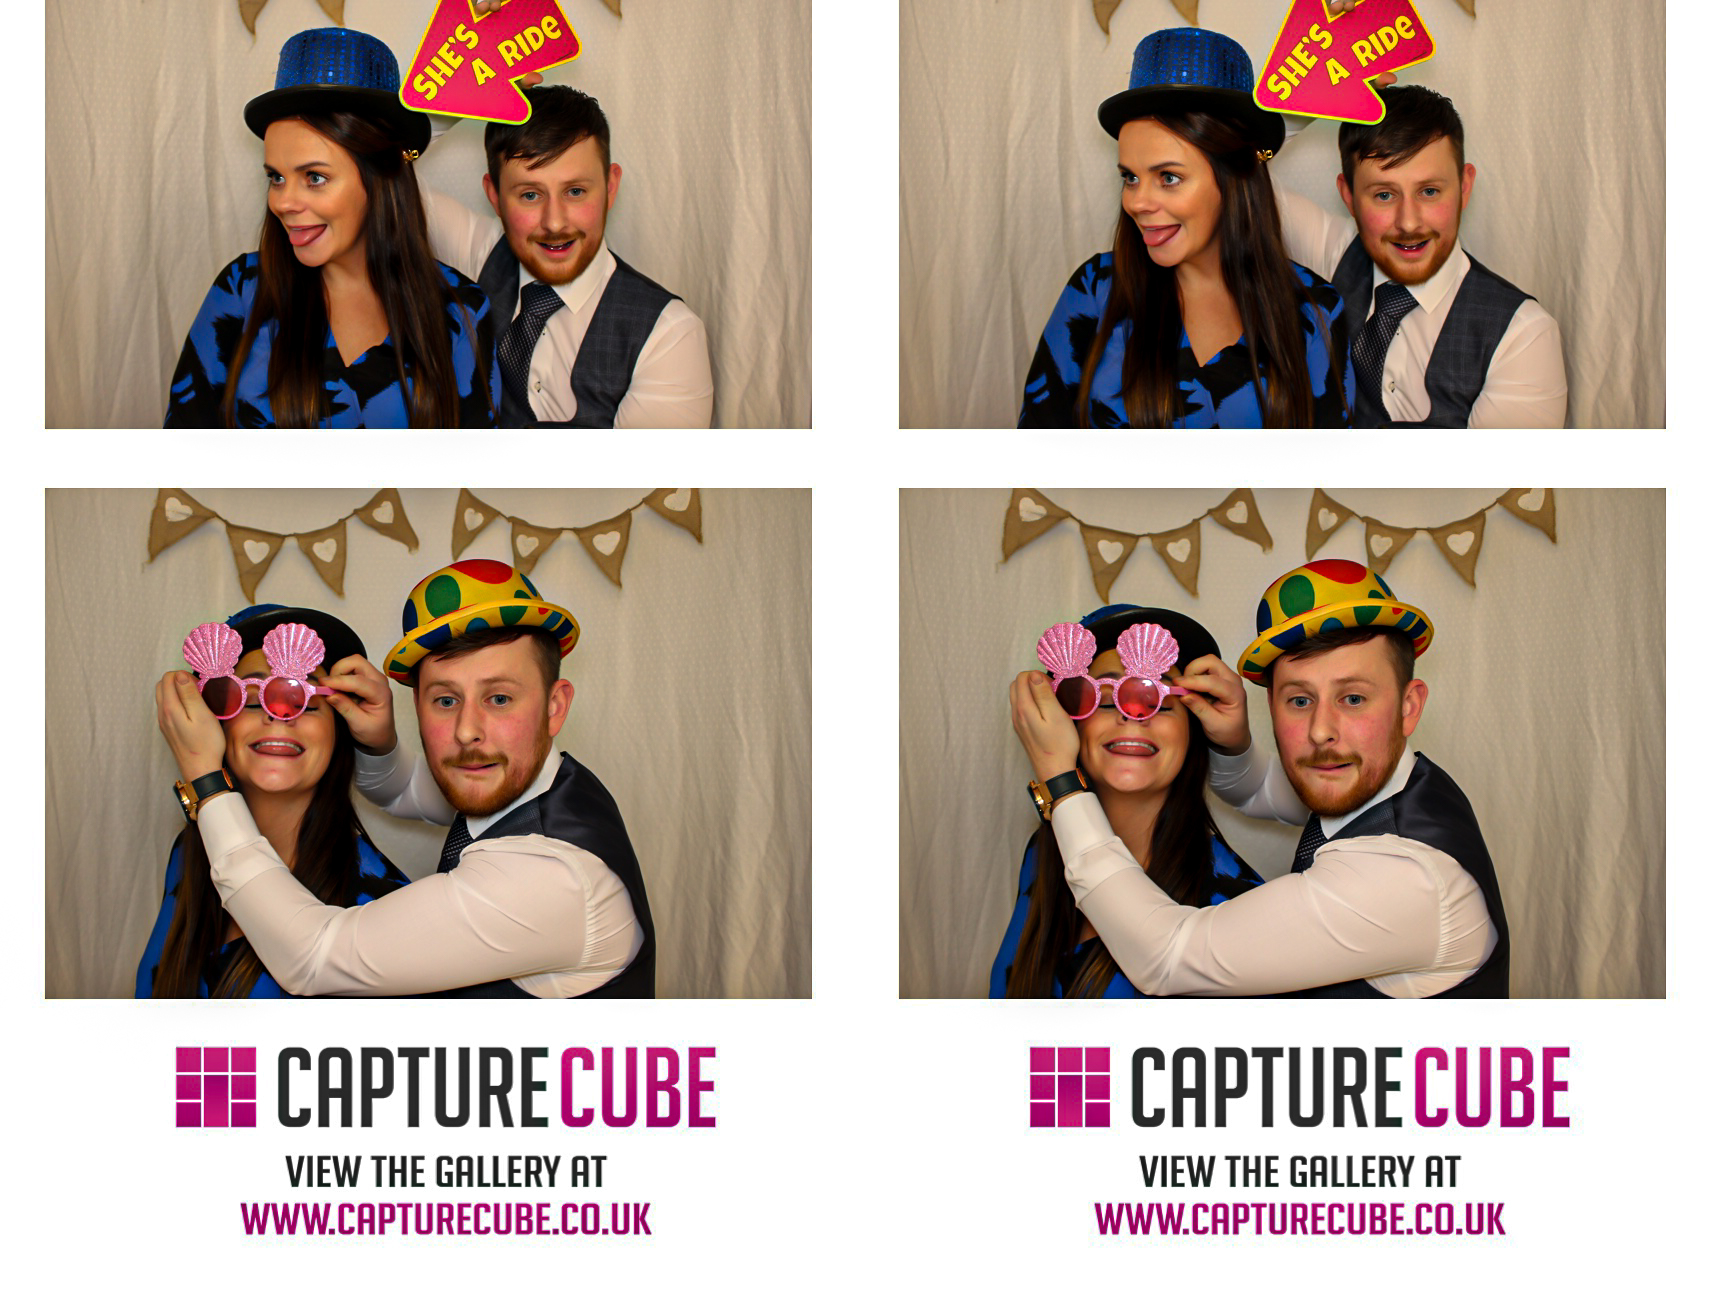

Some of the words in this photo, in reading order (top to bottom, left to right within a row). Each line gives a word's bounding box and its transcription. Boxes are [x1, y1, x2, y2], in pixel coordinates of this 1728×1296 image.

[412, 23, 480, 101] SHE'S
[471, 57, 497, 86] A
[1266, 23, 1334, 101] SHE'S
[1325, 57, 1351, 86] A
